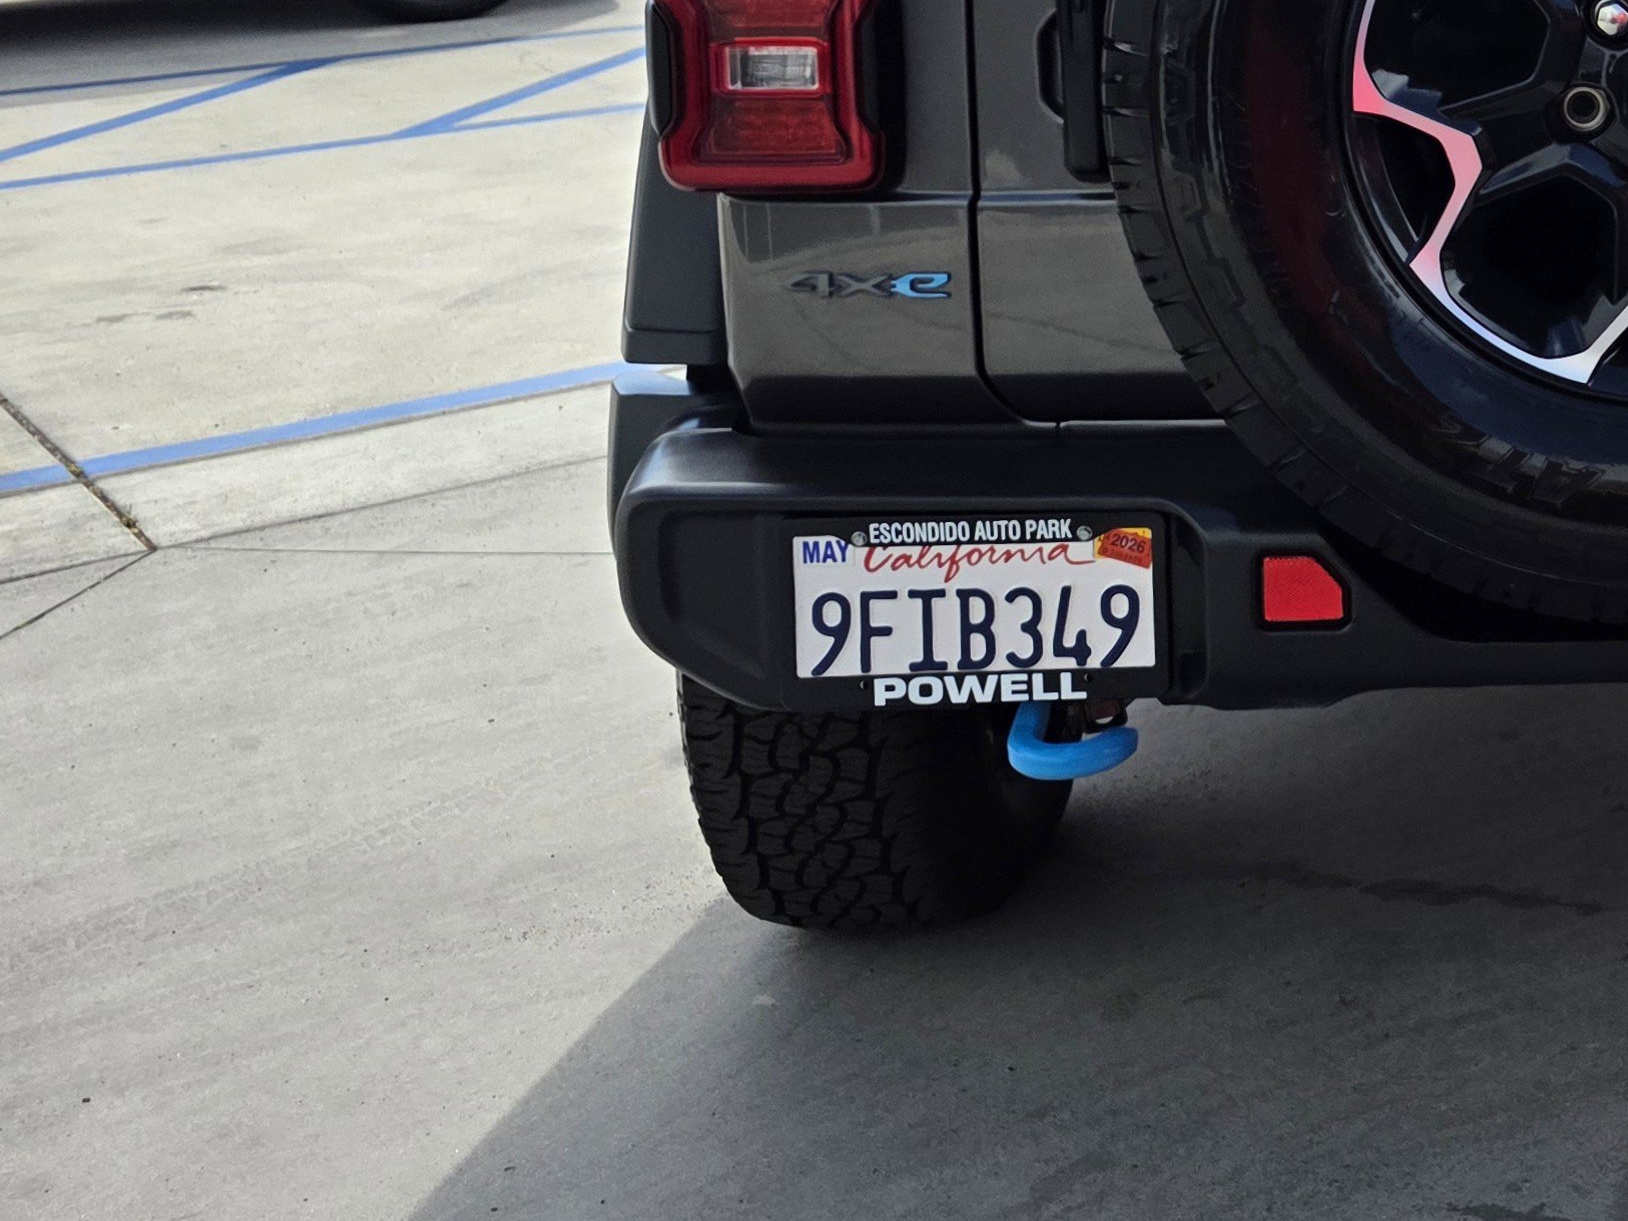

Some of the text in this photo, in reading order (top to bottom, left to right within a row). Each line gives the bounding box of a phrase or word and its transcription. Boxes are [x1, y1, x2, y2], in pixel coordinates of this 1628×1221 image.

[869, 518, 1072, 545] ESCONDIDO AUTO PARK
[1111, 533, 1147, 554] 2026
[802, 540, 849, 564] MAY
[864, 542, 1096, 583] California
[811, 584, 1140, 676] 9FIB349
[874, 672, 1087, 707] POWELL
